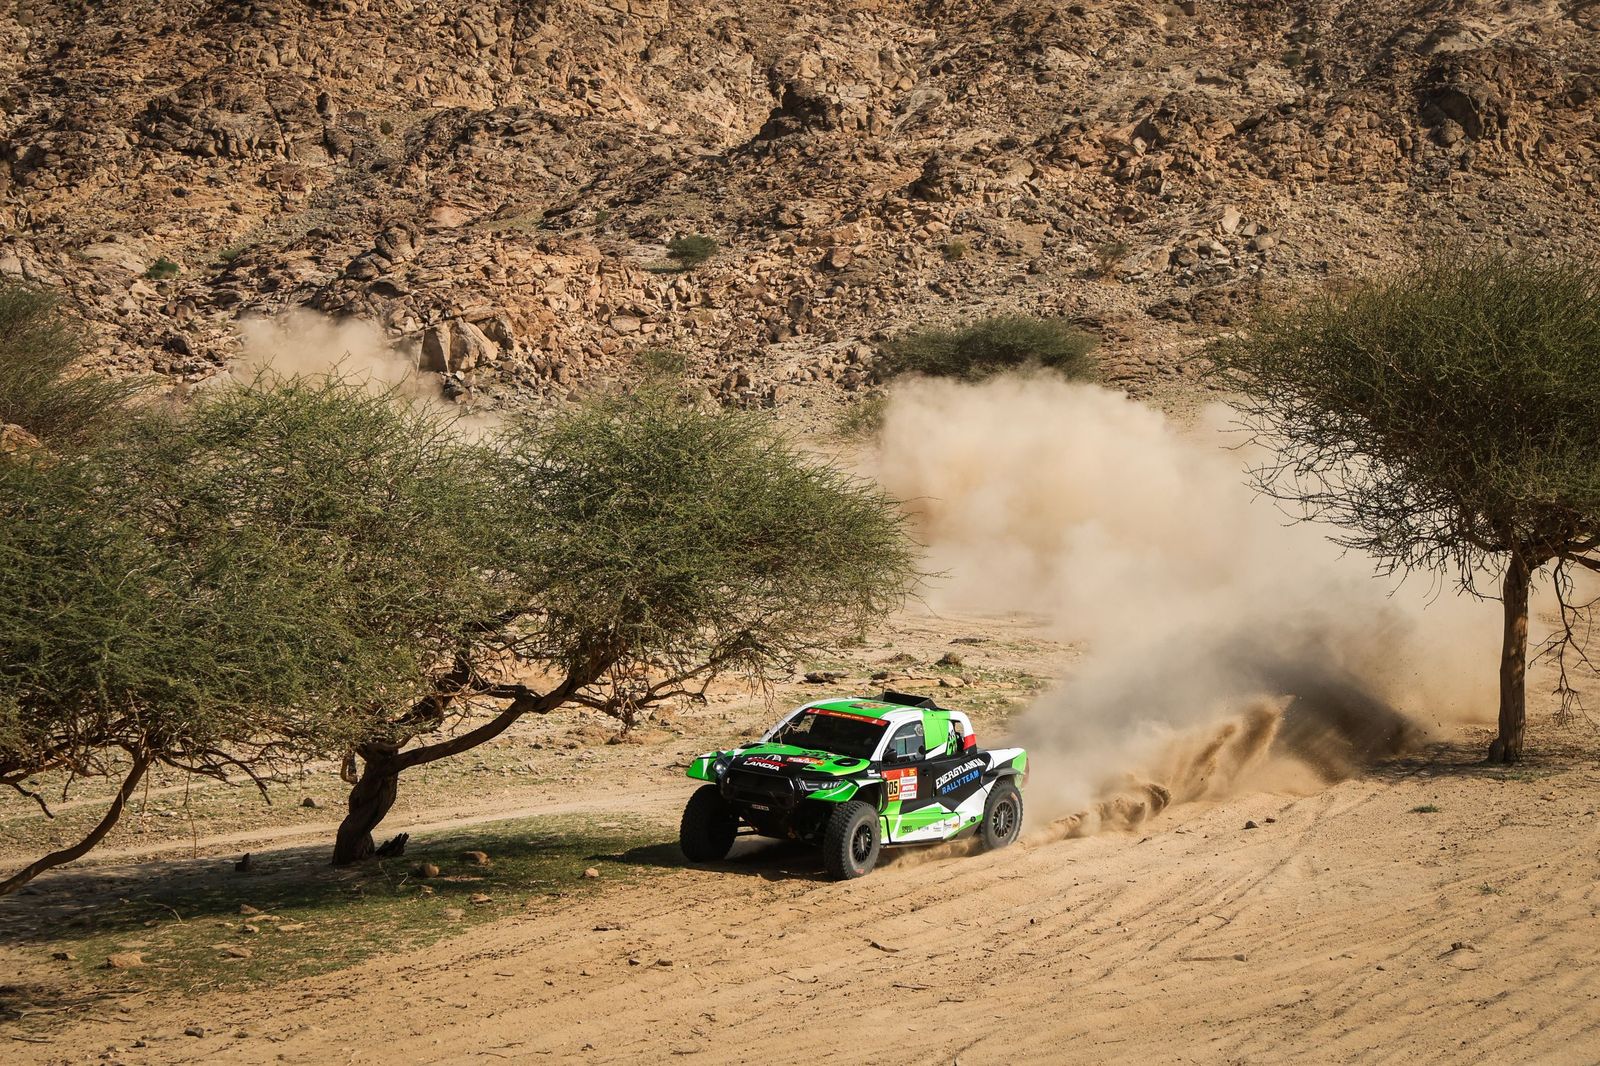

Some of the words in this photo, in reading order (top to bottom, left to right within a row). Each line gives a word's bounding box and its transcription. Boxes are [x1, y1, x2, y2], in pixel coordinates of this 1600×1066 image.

[742, 760, 780, 772] LANDIA
[942, 779, 961, 795] RALLY
[962, 769, 980, 784] TEAM
